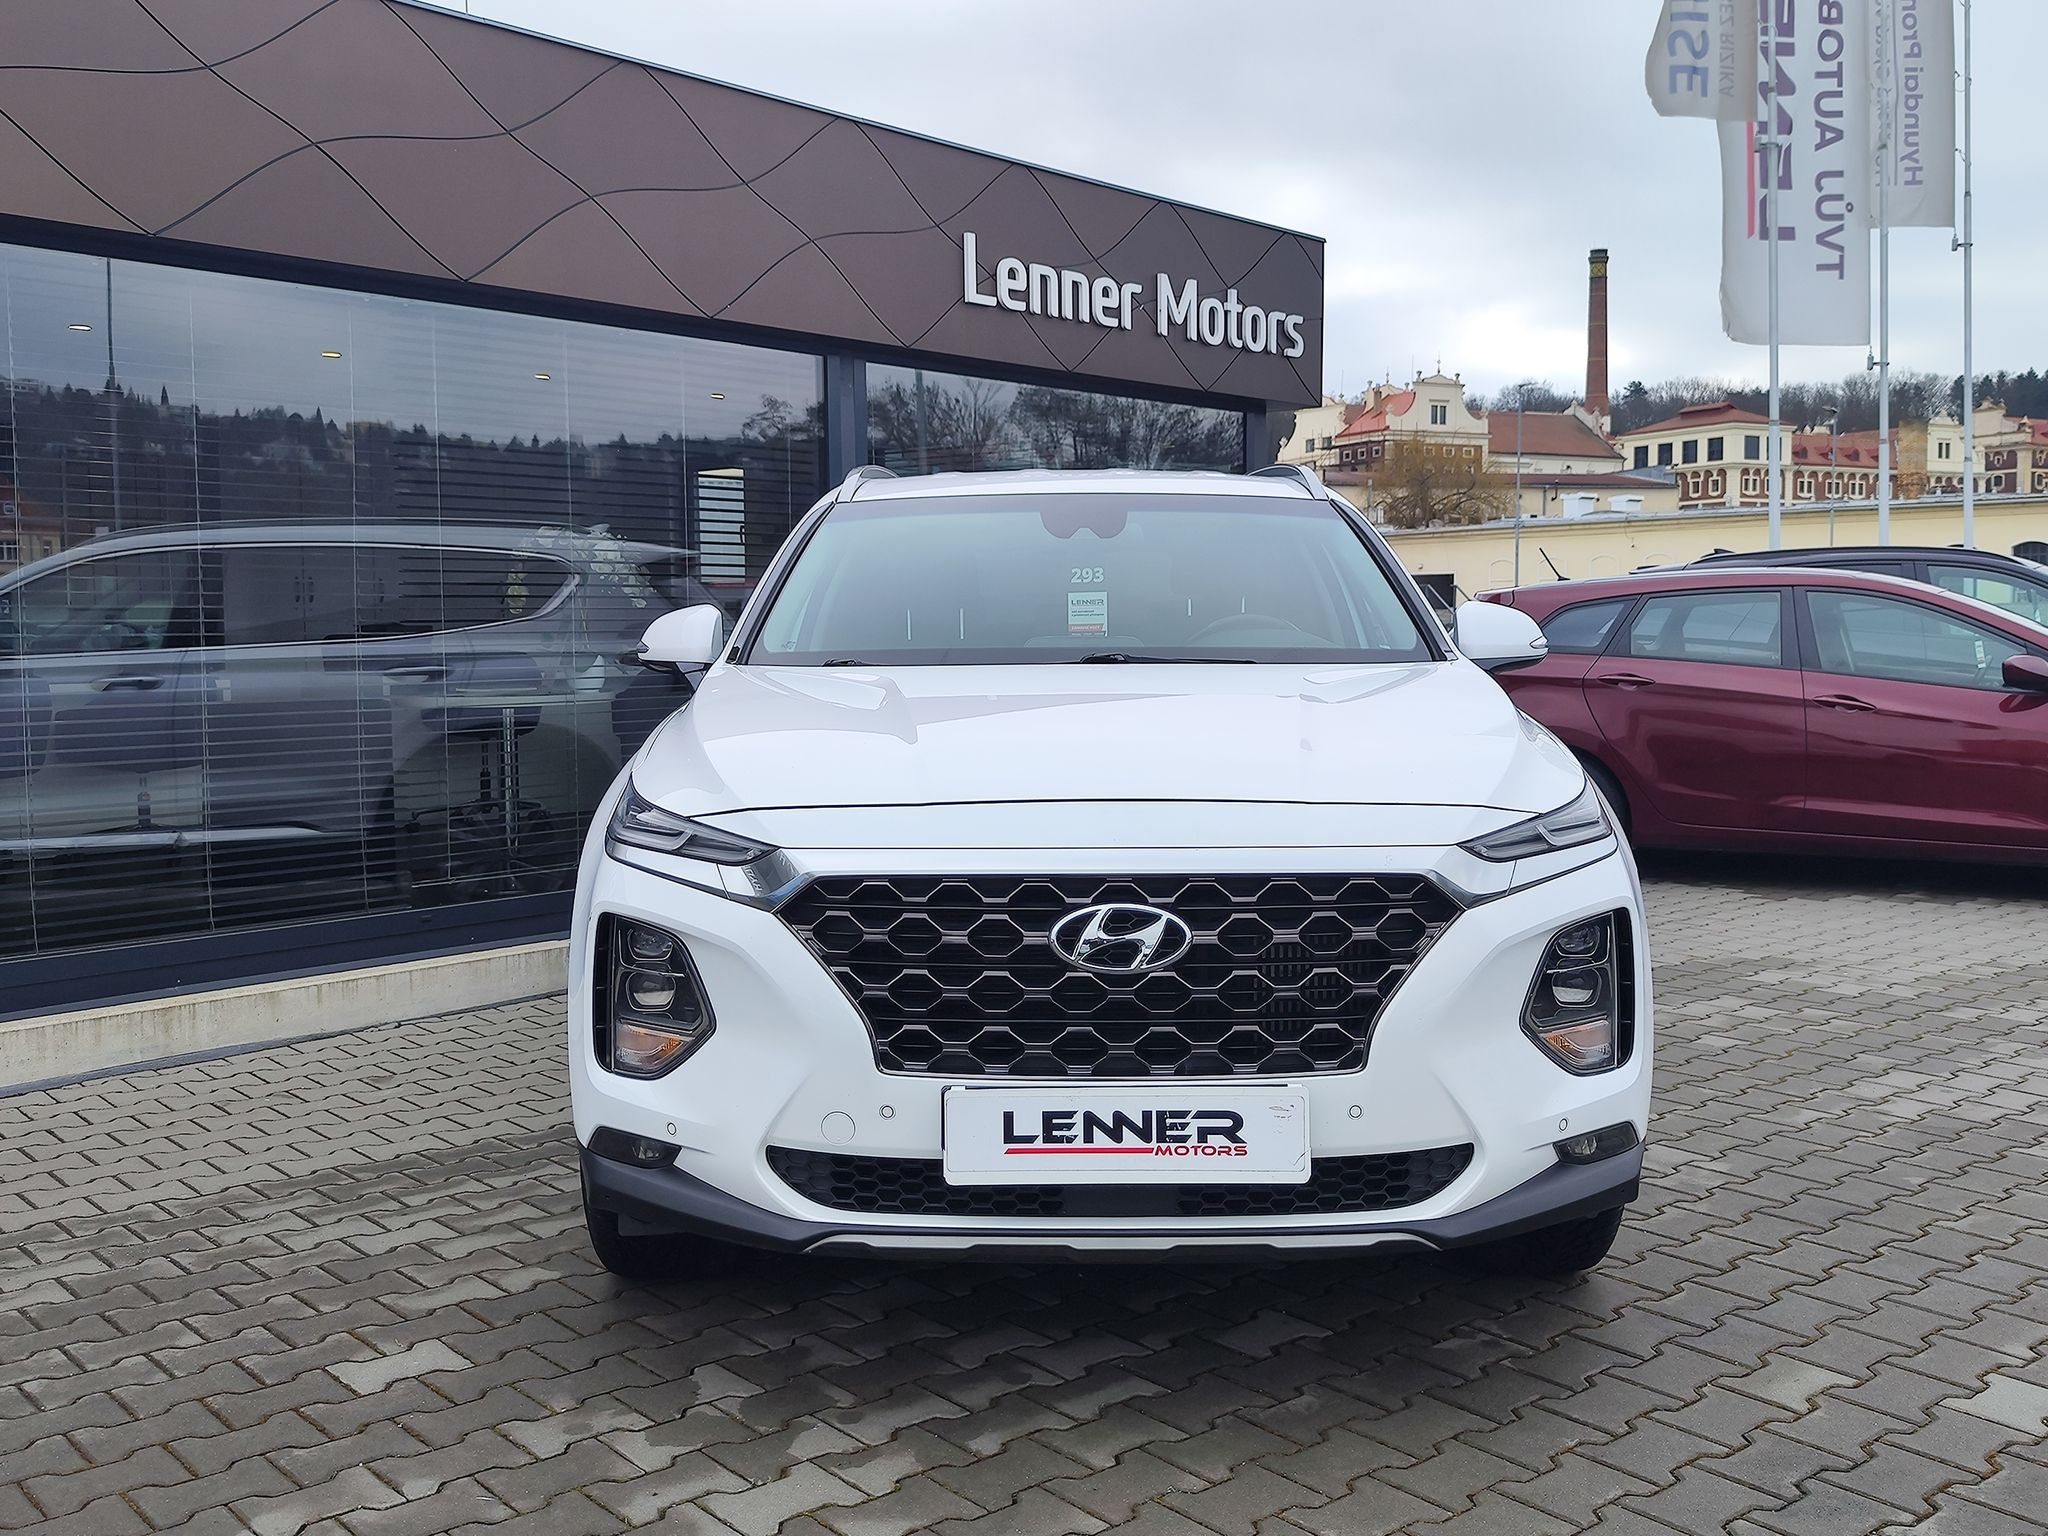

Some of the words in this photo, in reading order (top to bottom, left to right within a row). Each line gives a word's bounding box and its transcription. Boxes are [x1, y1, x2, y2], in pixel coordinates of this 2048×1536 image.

[963, 231, 1143, 330] Lenner
[1156, 272, 1304, 359] Motors
[1071, 567, 1105, 584] 293
[1003, 1109, 1248, 1145] LENNER
[1154, 1144, 1248, 1156] MOTORS
